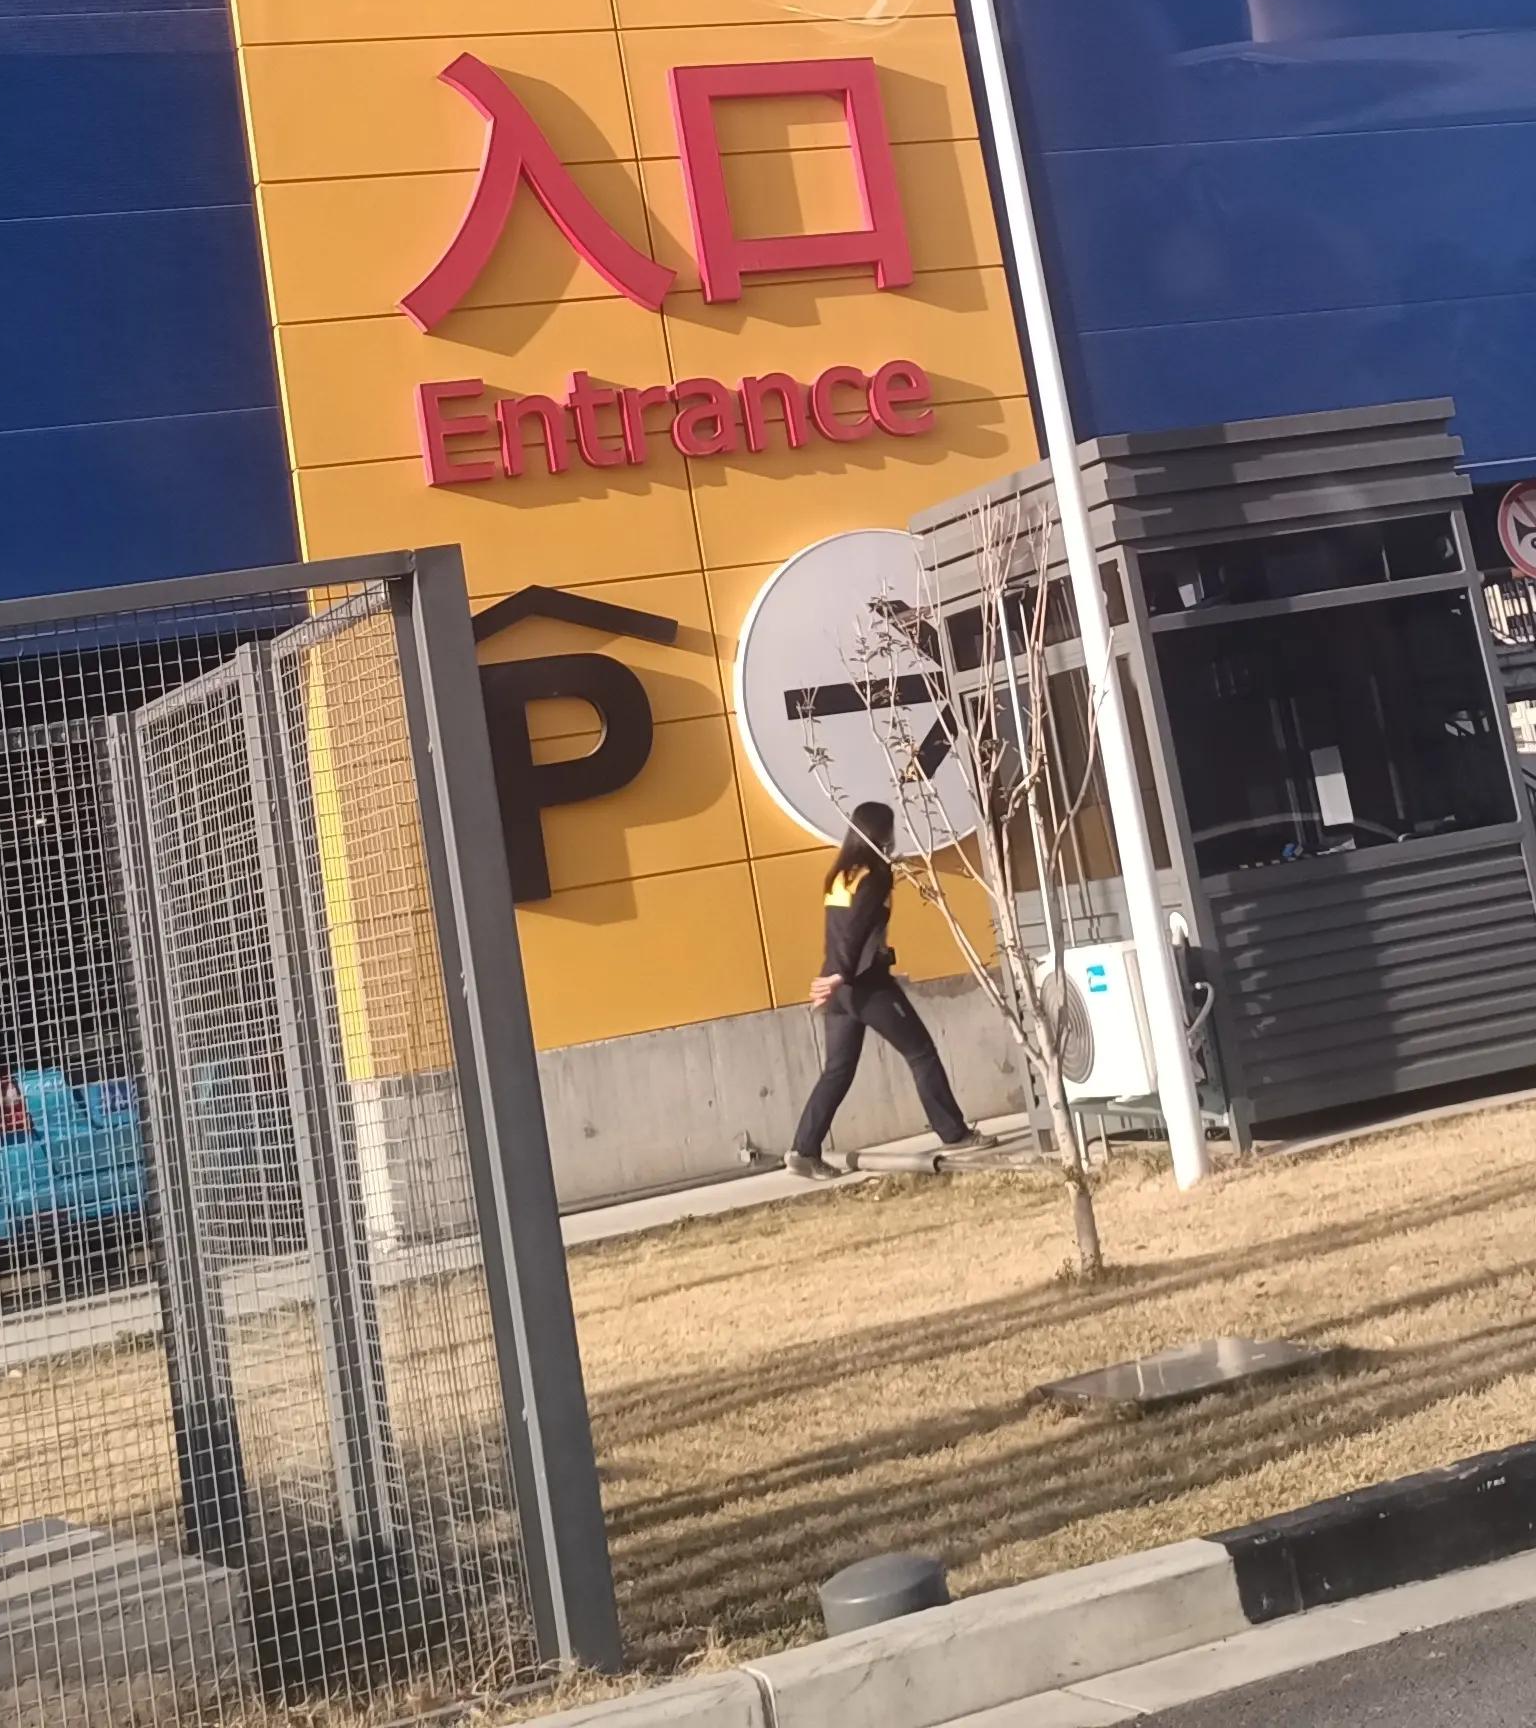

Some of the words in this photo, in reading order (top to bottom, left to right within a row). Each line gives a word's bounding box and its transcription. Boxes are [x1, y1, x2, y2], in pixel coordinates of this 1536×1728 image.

[398, 51, 914, 334] 入口
[415, 359, 936, 487] Entrance
[480, 652, 653, 903] P
